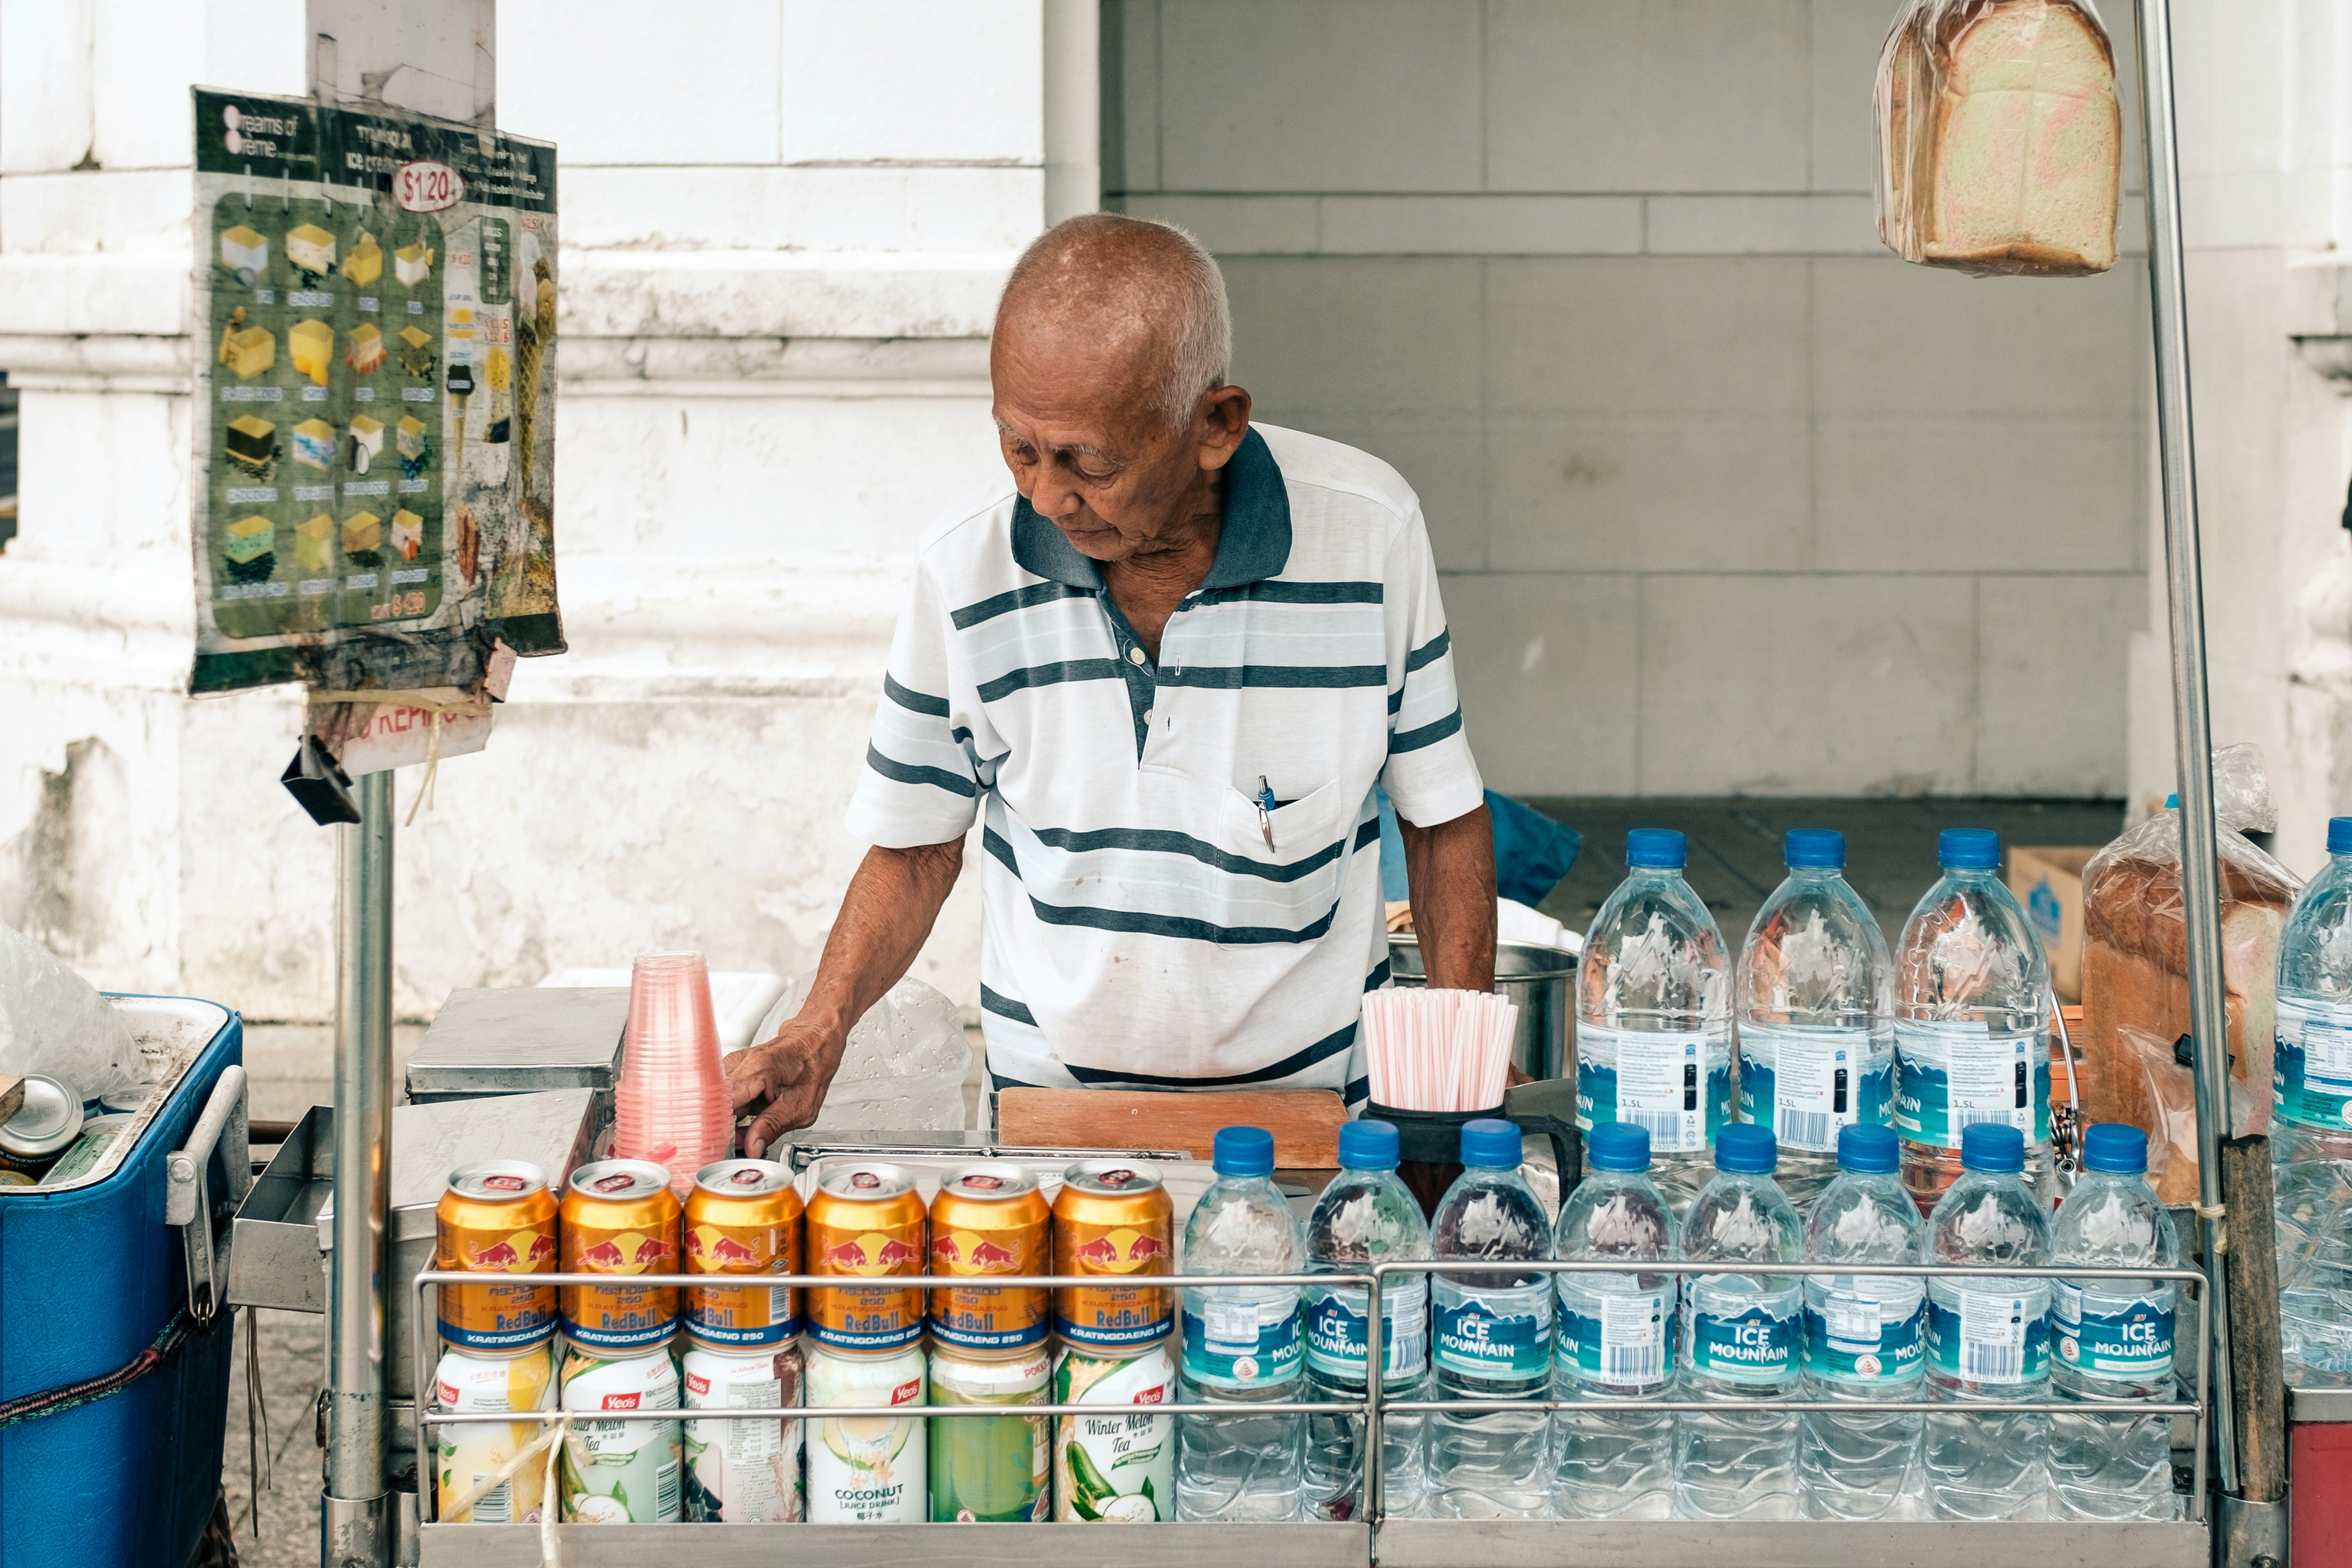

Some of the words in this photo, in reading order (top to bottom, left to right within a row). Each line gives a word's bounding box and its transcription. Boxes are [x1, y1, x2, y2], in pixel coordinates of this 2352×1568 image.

[404, 170, 449, 202] $1.20
[1622, 1099, 1643, 1108] 1.5L
[1779, 1098, 1796, 1108] 1.5L
[1953, 1100, 1975, 1108] 1.5L
[617, 1295, 642, 1304] 250
[860, 1297, 886, 1306] 250
[1111, 1293, 1137, 1301] 250
[497, 1303, 547, 1330] RedBull
[602, 1307, 656, 1330] RedBull
[845, 1311, 899, 1331] RedBull
[944, 1307, 993, 1331] RedBull
[1097, 1306, 1150, 1327] RedBull
[467, 1325, 551, 1344] KRATINGDAENG
[575, 1329, 661, 1343] KRATINGDAENG
[742, 1331, 764, 1341] 250
[1070, 1327, 1154, 1340] KRATINGDAENG
[1319, 1315, 1348, 1339] ICE
[1457, 1318, 1490, 1341] ICE
[1735, 1326, 1771, 1346] ICE
[2122, 1322, 2156, 1342] ICE
[820, 1330, 905, 1345] KRATINGDAENG
[1002, 1333, 1023, 1344] 250
[1308, 1329, 1368, 1357] MOUNTAIN
[1440, 1333, 1515, 1359] MOUNTAIN
[1709, 1341, 1788, 1365] MOUNTAIN
[2094, 1338, 2172, 1359] MOUNTAIN
[688, 1374, 707, 1393] Yeo's
[897, 1385, 918, 1401] Yeo's
[1138, 1391, 1162, 1404] Yeo's
[608, 1396, 636, 1409] Yeo's
[1085, 1419, 1122, 1436] Winter
[1125, 1414, 1154, 1432] Melon
[586, 1435, 600, 1451] Tea
[1112, 1437, 1131, 1454] Tea
[835, 1483, 904, 1500] COCONUT
